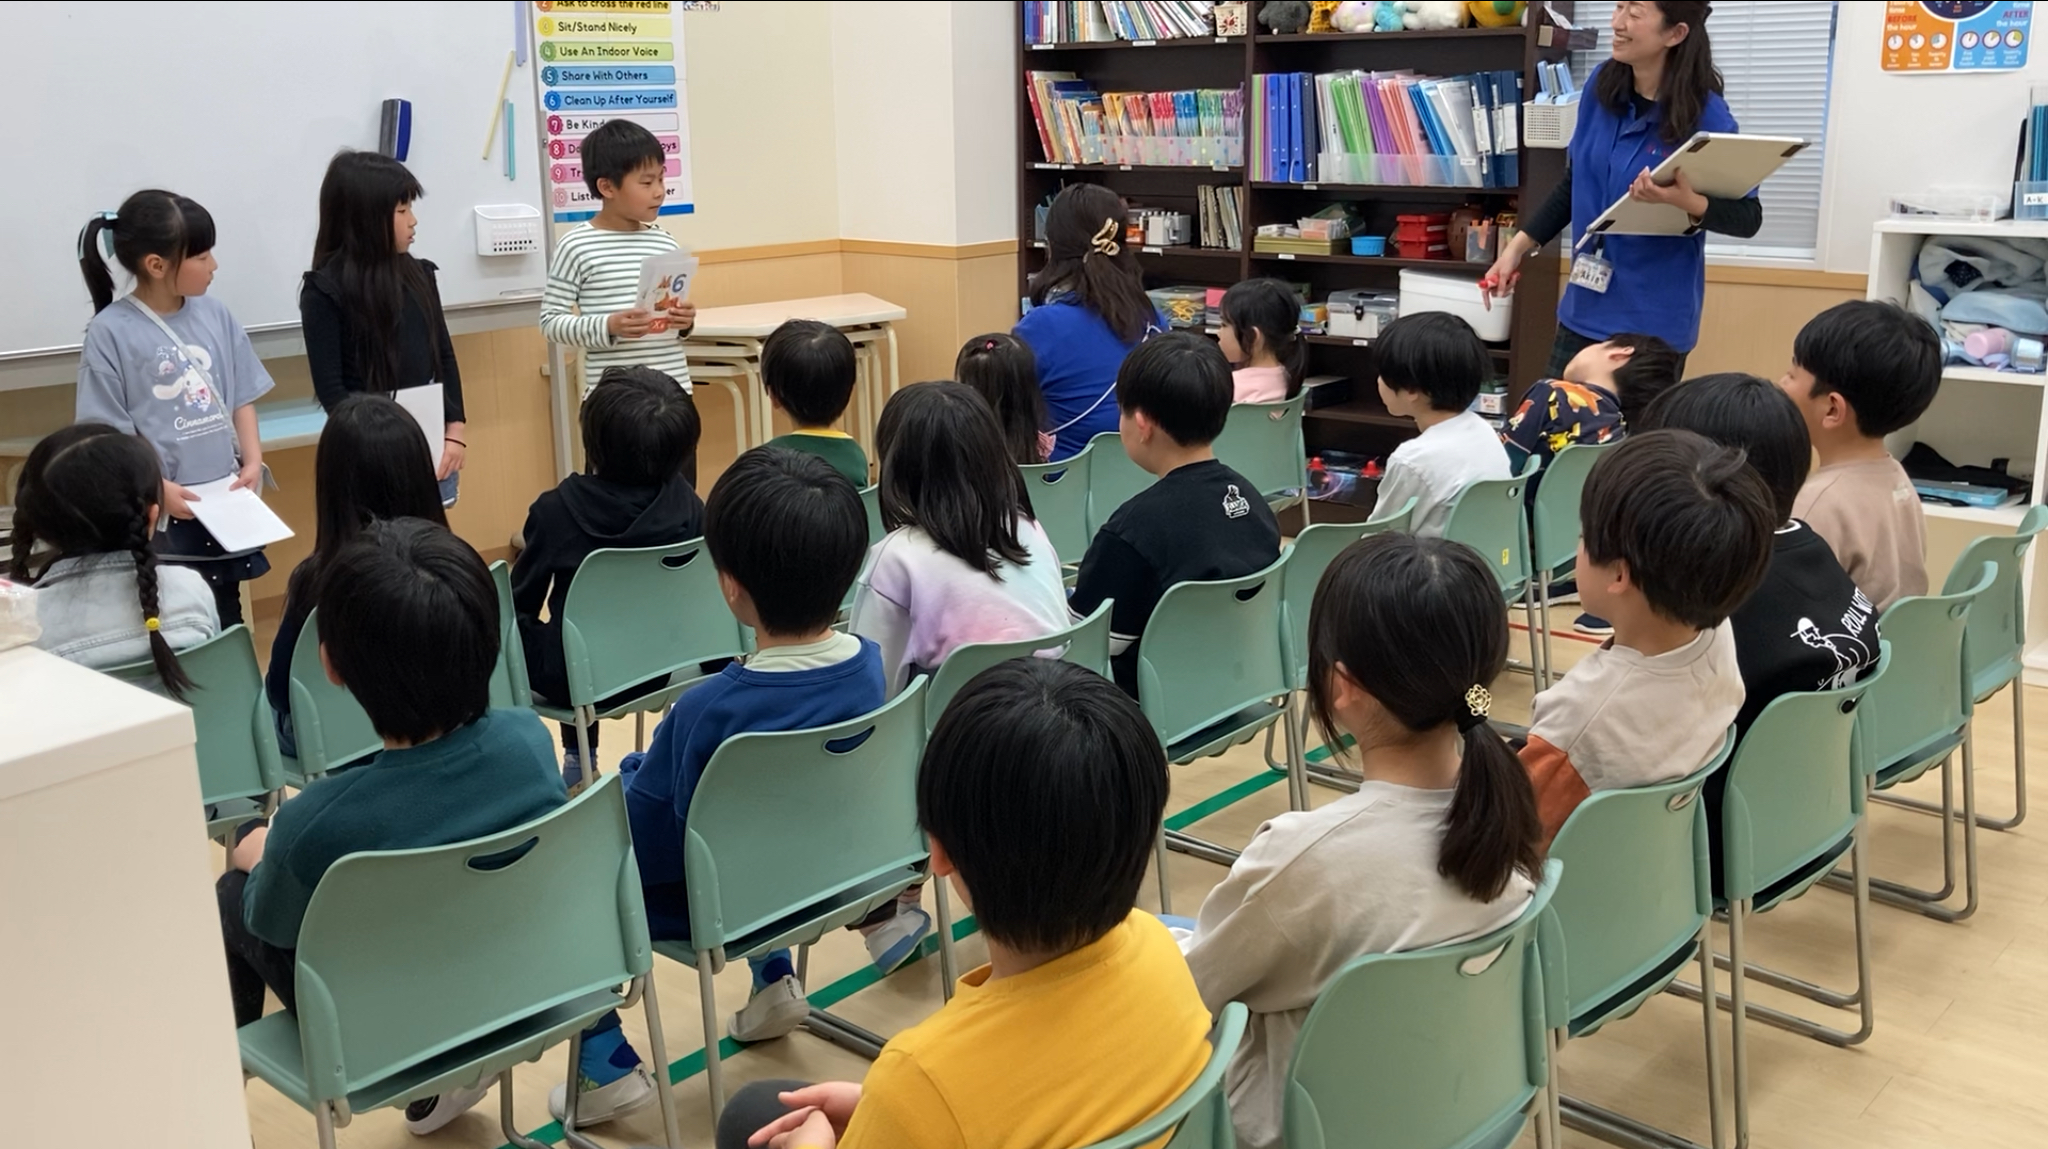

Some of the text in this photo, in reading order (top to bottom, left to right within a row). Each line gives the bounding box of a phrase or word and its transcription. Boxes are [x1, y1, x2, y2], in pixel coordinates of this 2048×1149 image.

[636, 1, 651, 9] red
[1887, 15, 1917, 23] BEFORE
[558, 21, 606, 32] Sit/Stand
[608, 22, 637, 35] Nicely
[560, 47, 578, 56] Use
[581, 47, 595, 56] An
[597, 47, 630, 56] Indoor
[632, 46, 659, 56] Voice
[562, 70, 591, 81] Share
[592, 70, 614, 80] With
[615, 70, 649, 80] Others
[564, 95, 592, 105] Clean
[593, 95, 607, 107] Up
[608, 94, 634, 105] After
[635, 93, 674, 103] Yourself
[566, 119, 579, 129] Be
[660, 142, 677, 152] oys
[571, 192, 596, 202] Liste
[672, 273, 687, 293] 6
[1841, 606, 1868, 638] ROLL
